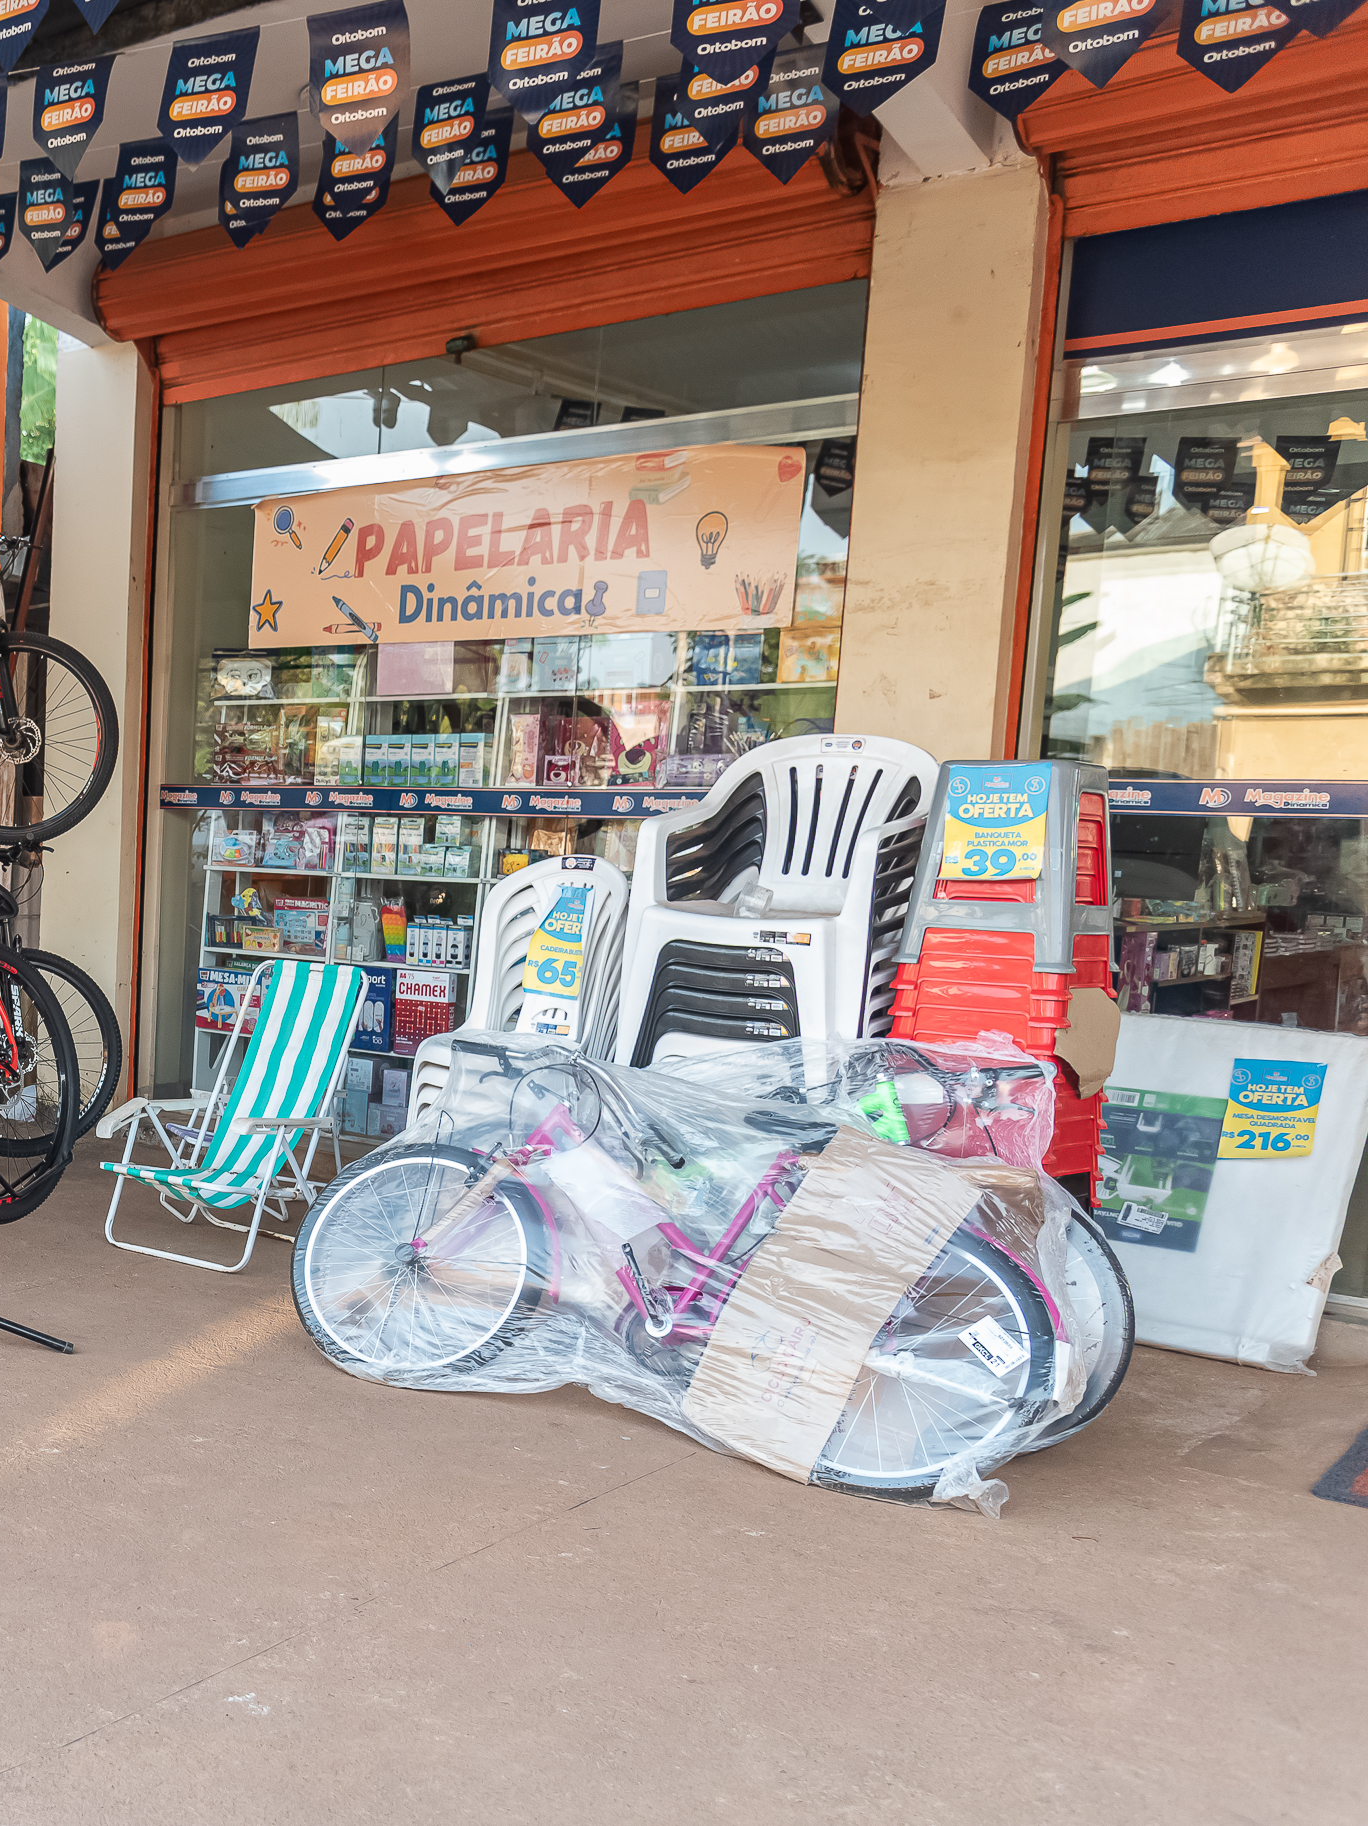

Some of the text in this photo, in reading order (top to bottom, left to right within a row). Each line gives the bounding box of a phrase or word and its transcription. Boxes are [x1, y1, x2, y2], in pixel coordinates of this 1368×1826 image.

[505, 8, 581, 40] MEGA
[692, 2, 777, 30] FEIRÃO
[1199, 12, 1287, 41] FEIRÃO
[332, 26, 386, 46] Ortobom
[1068, 29, 1139, 53] Ortobom
[505, 36, 578, 65] FEIRÃO
[697, 36, 767, 56] Ortobom
[1203, 40, 1276, 63] Ortobom
[188, 53, 236, 68] Ortobom
[324, 47, 394, 77] MEGA
[842, 44, 919, 70] FEIRÃO
[52, 61, 96, 77] Ortobom
[175, 71, 236, 95] MEGA
[326, 75, 393, 101] FEIRÃO
[432, 82, 475, 97] Ortobom
[508, 71, 568, 90] Ortobom
[843, 72, 906, 91] Ortobom
[989, 73, 1050, 95] Ortobom
[44, 79, 95, 105] MEGA
[758, 85, 824, 113] MEGA
[44, 102, 92, 126] FEIRÃO
[172, 95, 232, 116] FEIRÃO
[424, 98, 475, 123] MEGA
[694, 101, 744, 119] Ortobom
[331, 107, 387, 124] Ortobom
[542, 111, 601, 134] FEIRÃO
[758, 110, 822, 134] FEIRÃO
[47, 131, 87, 149] Ortobom
[173, 125, 222, 138] Ortobom
[423, 122, 471, 145] FEIRÃO
[543, 140, 591, 155] Ortobom
[762, 138, 814, 155] Ortobom
[238, 151, 289, 170] MEGA
[427, 150, 464, 165] Ortobom
[666, 154, 715, 170] Ortobom
[122, 171, 166, 189] MEGA
[238, 173, 287, 189] FEIRÃO
[563, 169, 610, 184] Ortobom
[334, 180, 374, 192] Ortobom
[26, 187, 64, 205] MEGA
[120, 191, 164, 205] FEIRÃO
[445, 191, 487, 204] Ortobom
[27, 206, 63, 222] FEIRÃO
[354, 499, 650, 578] PAPELARIA
[398, 577, 583, 624] Dinâmica
[161, 790, 198, 803] Magazine
[240, 791, 281, 804] Magazine
[328, 792, 374, 805] Magazine
[425, 793, 473, 808] Magazine
[529, 795, 582, 809] Magazine
[967, 793, 1028, 804] HOJE TEM
[1244, 788, 1330, 808] Magazine
[958, 803, 1034, 818] OFERTA
[974, 831, 1022, 839] BANQUETA
[398, 981, 447, 998] CHAMEX
[1248, 1083, 1304, 1094] HOJE TEM
[1238, 1091, 1309, 1107] OFERTA
[1232, 1112, 1316, 1124] MESA DESMONTAVEL
[1249, 1120, 1296, 1129] QUADRADA
